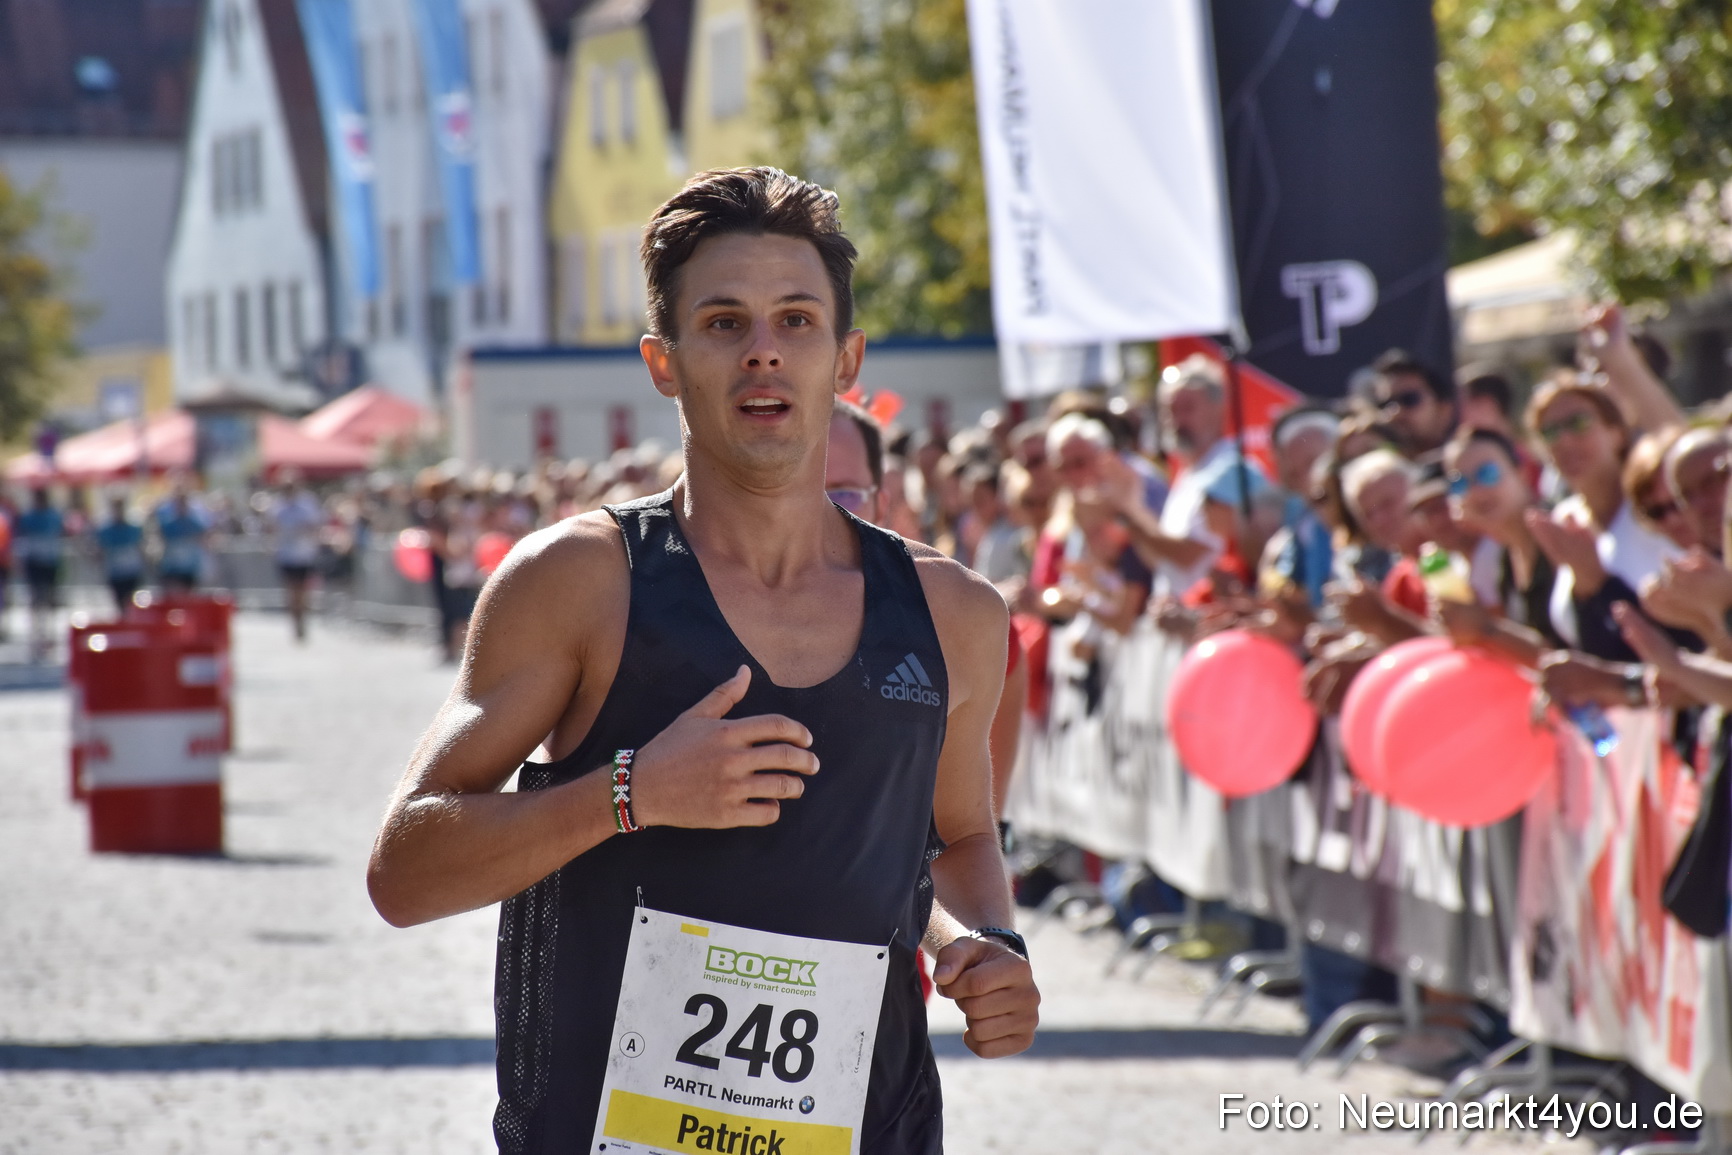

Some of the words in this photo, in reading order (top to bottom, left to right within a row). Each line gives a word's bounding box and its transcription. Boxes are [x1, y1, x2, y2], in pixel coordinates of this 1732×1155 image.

[880, 682, 941, 707] adidas
[703, 971, 739, 986] inspired
[740, 978, 752, 989] by
[753, 981, 780, 993] smart
[780, 986, 817, 998] concepts
[705, 945, 820, 988] BOCK
[625, 1038, 637, 1053] A
[675, 993, 819, 1084] 248
[663, 1075, 717, 1099] PARTL
[721, 1087, 794, 1111] Neumarkt
[676, 1113, 786, 1155] Patrick
